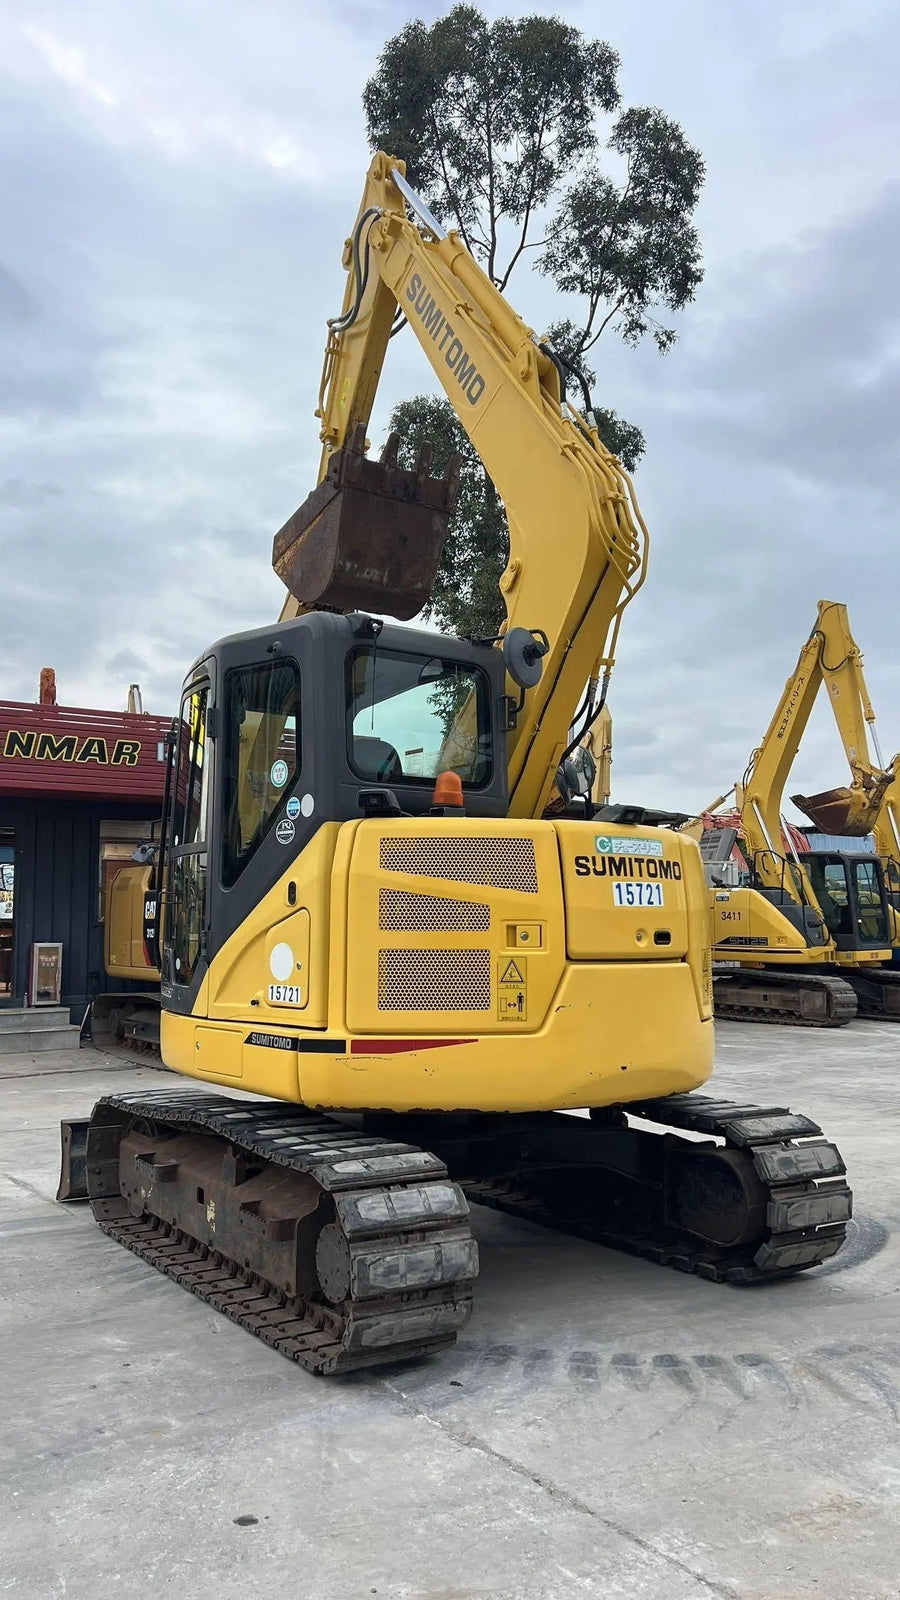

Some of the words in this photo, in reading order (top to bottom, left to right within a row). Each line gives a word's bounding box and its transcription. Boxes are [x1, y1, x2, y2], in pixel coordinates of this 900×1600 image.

[406, 273, 486, 405] SUMITOMO
[3, 730, 141, 766] NMAR
[575, 855, 682, 880] SUMITOMO
[615, 883, 662, 905] 15721
[721, 911, 741, 921] 3411
[269, 985, 299, 1002] 15721
[251, 1033, 292, 1049] SUMITOMO
